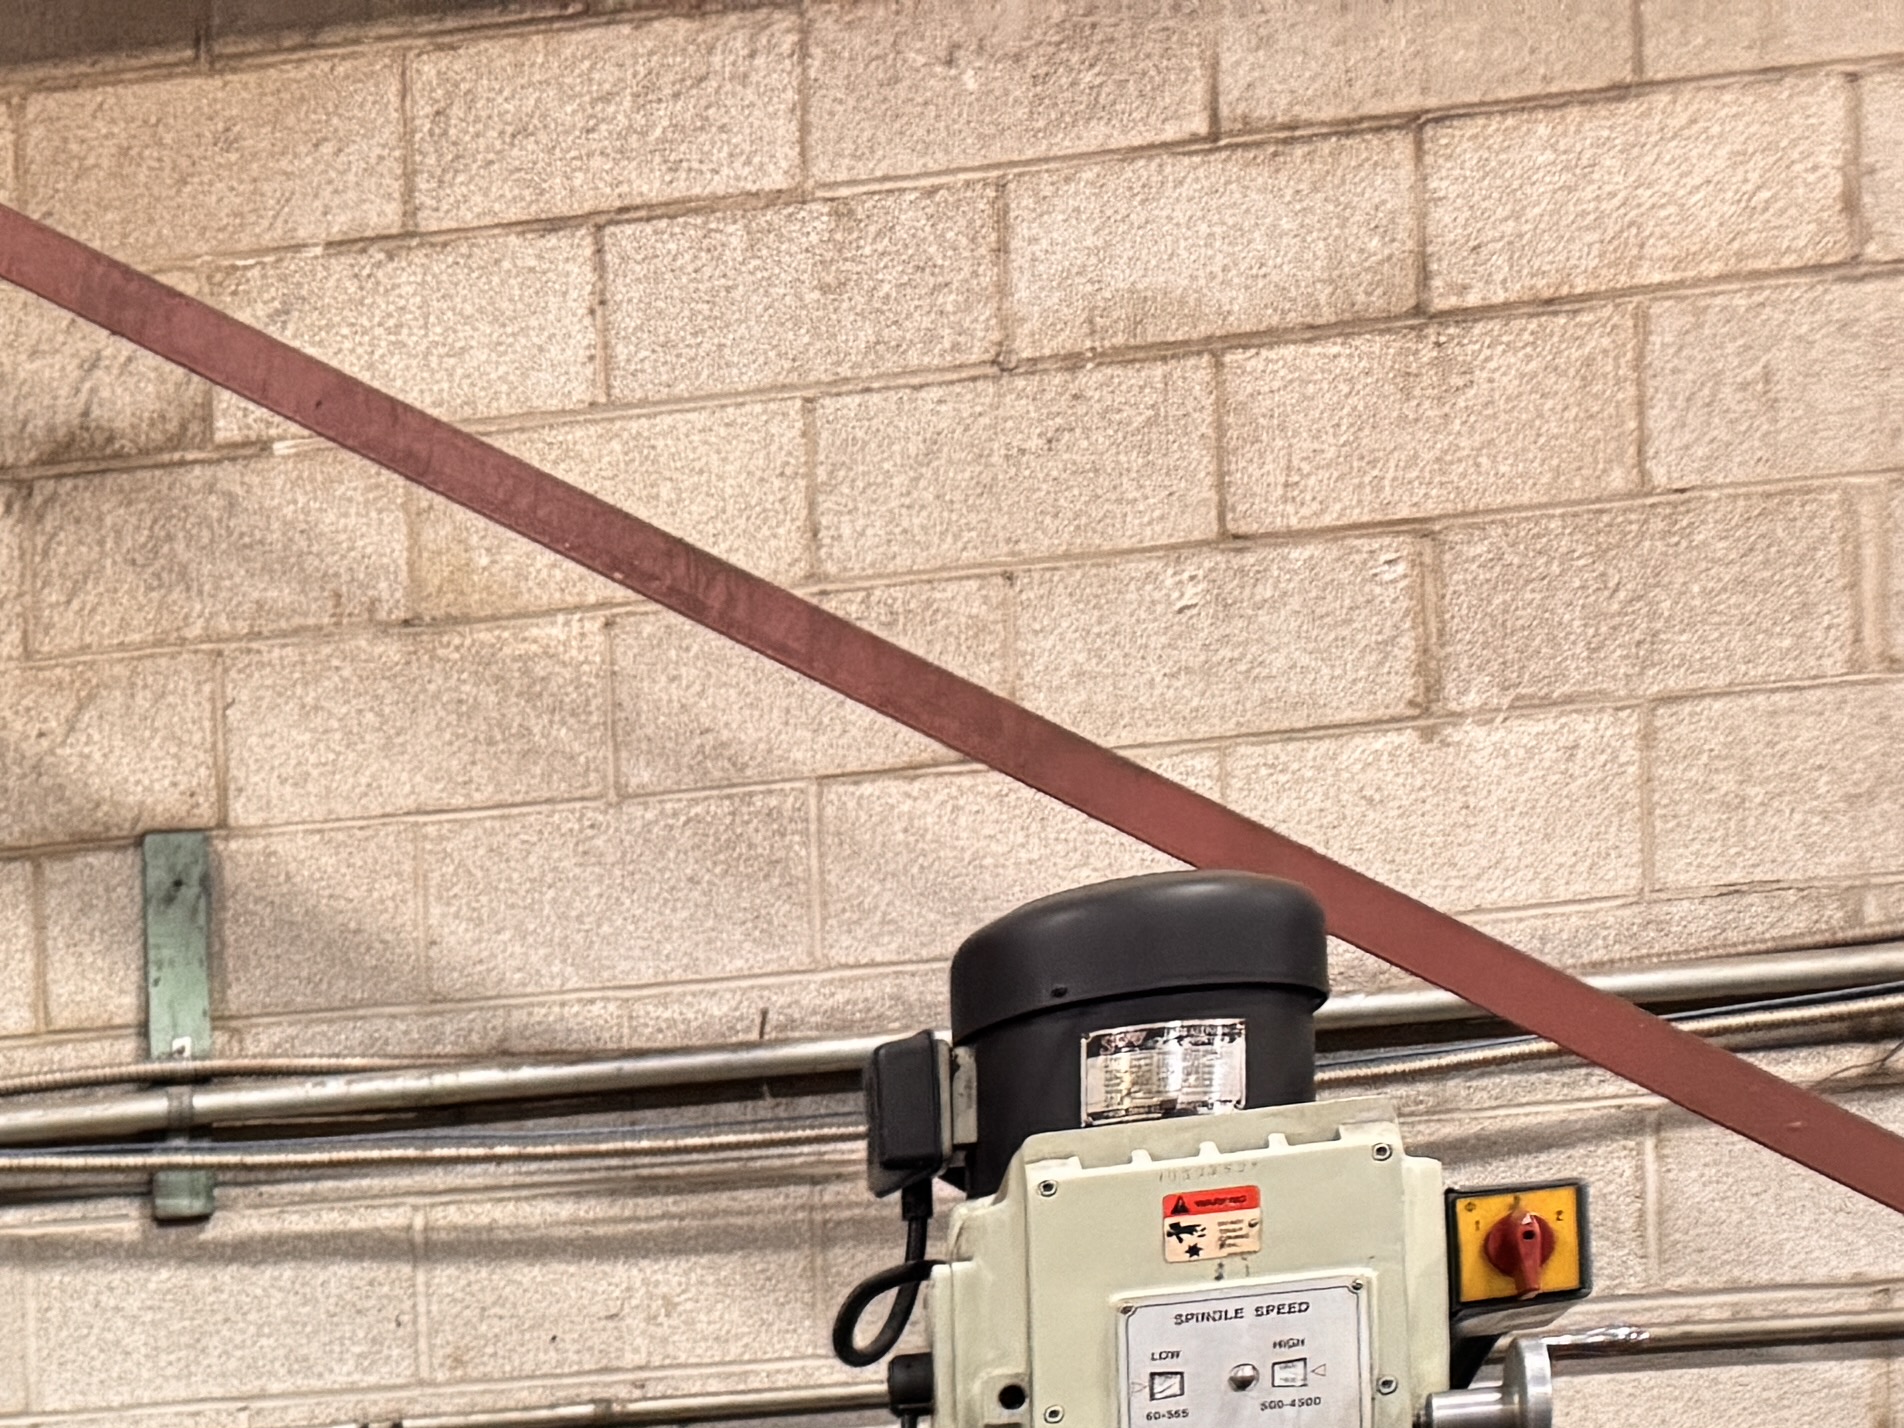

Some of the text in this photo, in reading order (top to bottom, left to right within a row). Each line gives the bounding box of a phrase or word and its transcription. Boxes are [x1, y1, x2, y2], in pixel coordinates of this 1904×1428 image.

[1173, 1301, 1311, 1326] SPINDLE SPEED
[1272, 1338, 1305, 1350] HIGH
[1150, 1350, 1182, 1361] LOW
